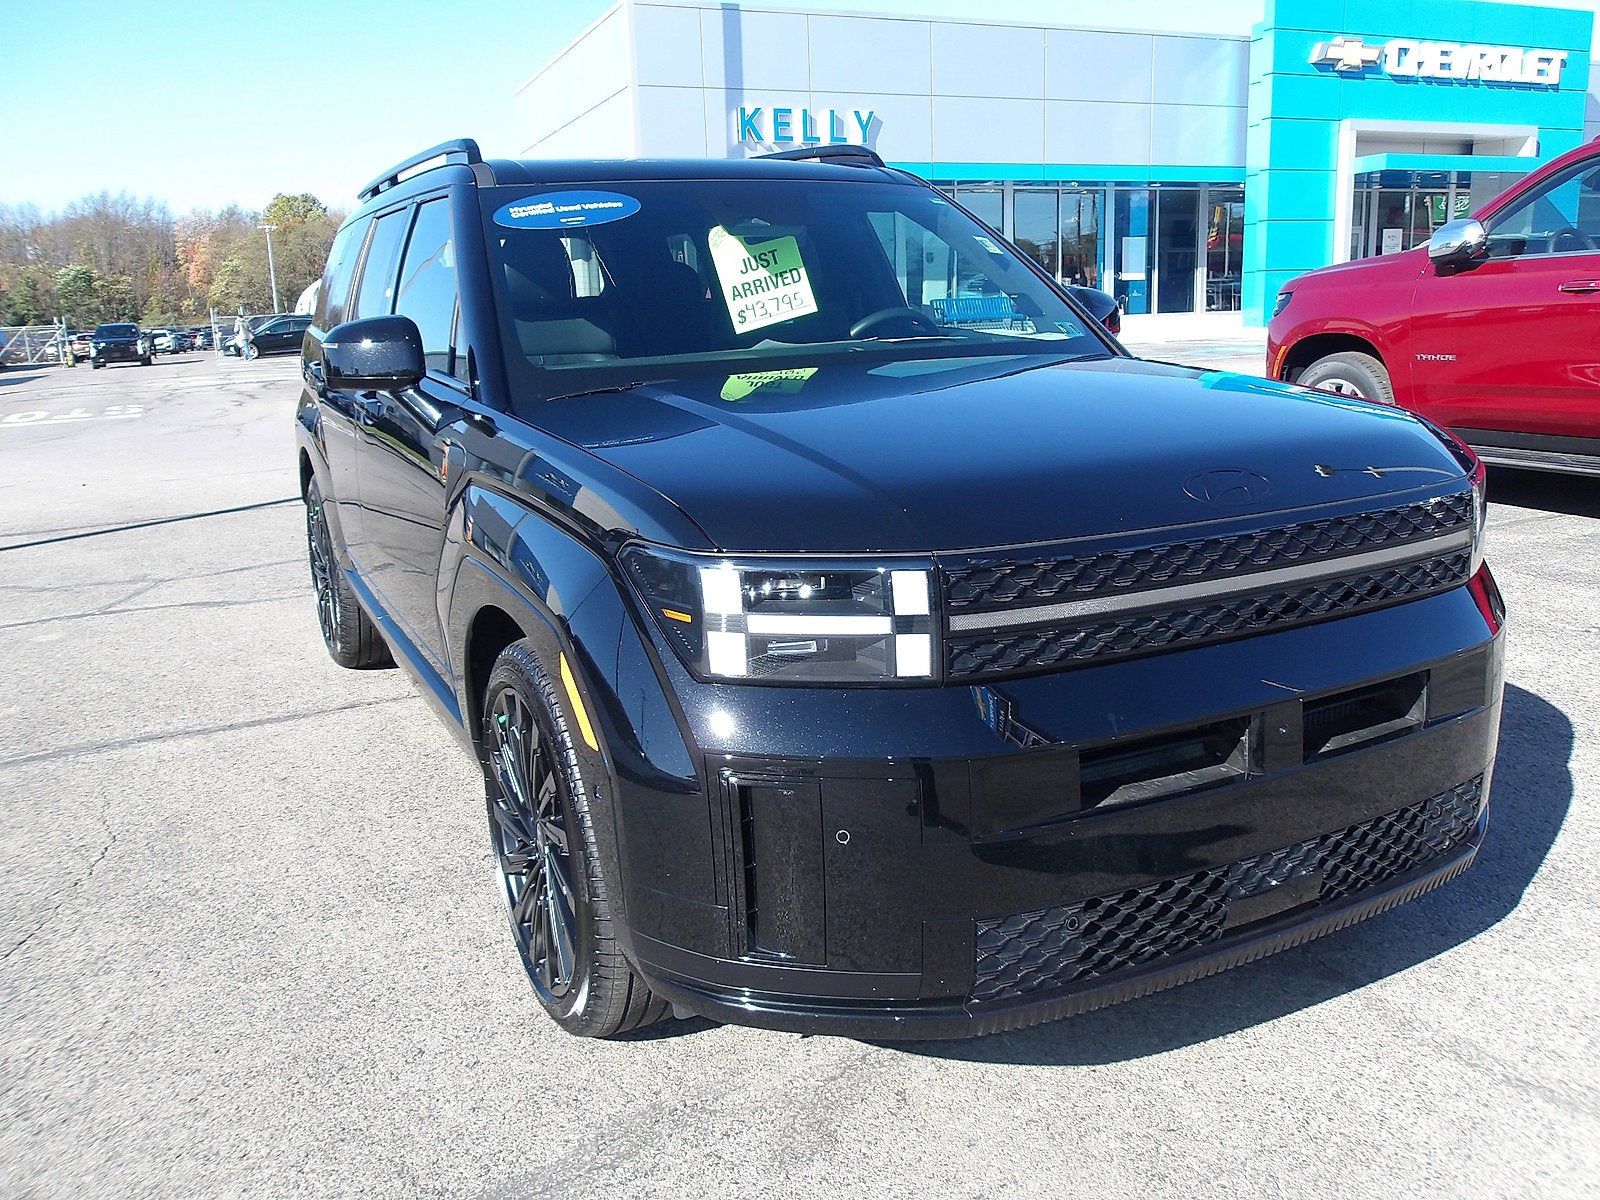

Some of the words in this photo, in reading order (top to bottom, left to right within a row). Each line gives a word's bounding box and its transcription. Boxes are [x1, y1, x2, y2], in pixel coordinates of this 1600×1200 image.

[1384, 39, 1568, 85] CHEVROLET
[738, 106, 875, 143] KELLY
[555, 203, 582, 213] Used
[582, 200, 624, 211] Vehicles
[740, 248, 779, 275] JUST
[731, 267, 802, 301] ARRIVED
[737, 292, 805, 325] $43,795
[1415, 353, 1457, 361] TAHOE
